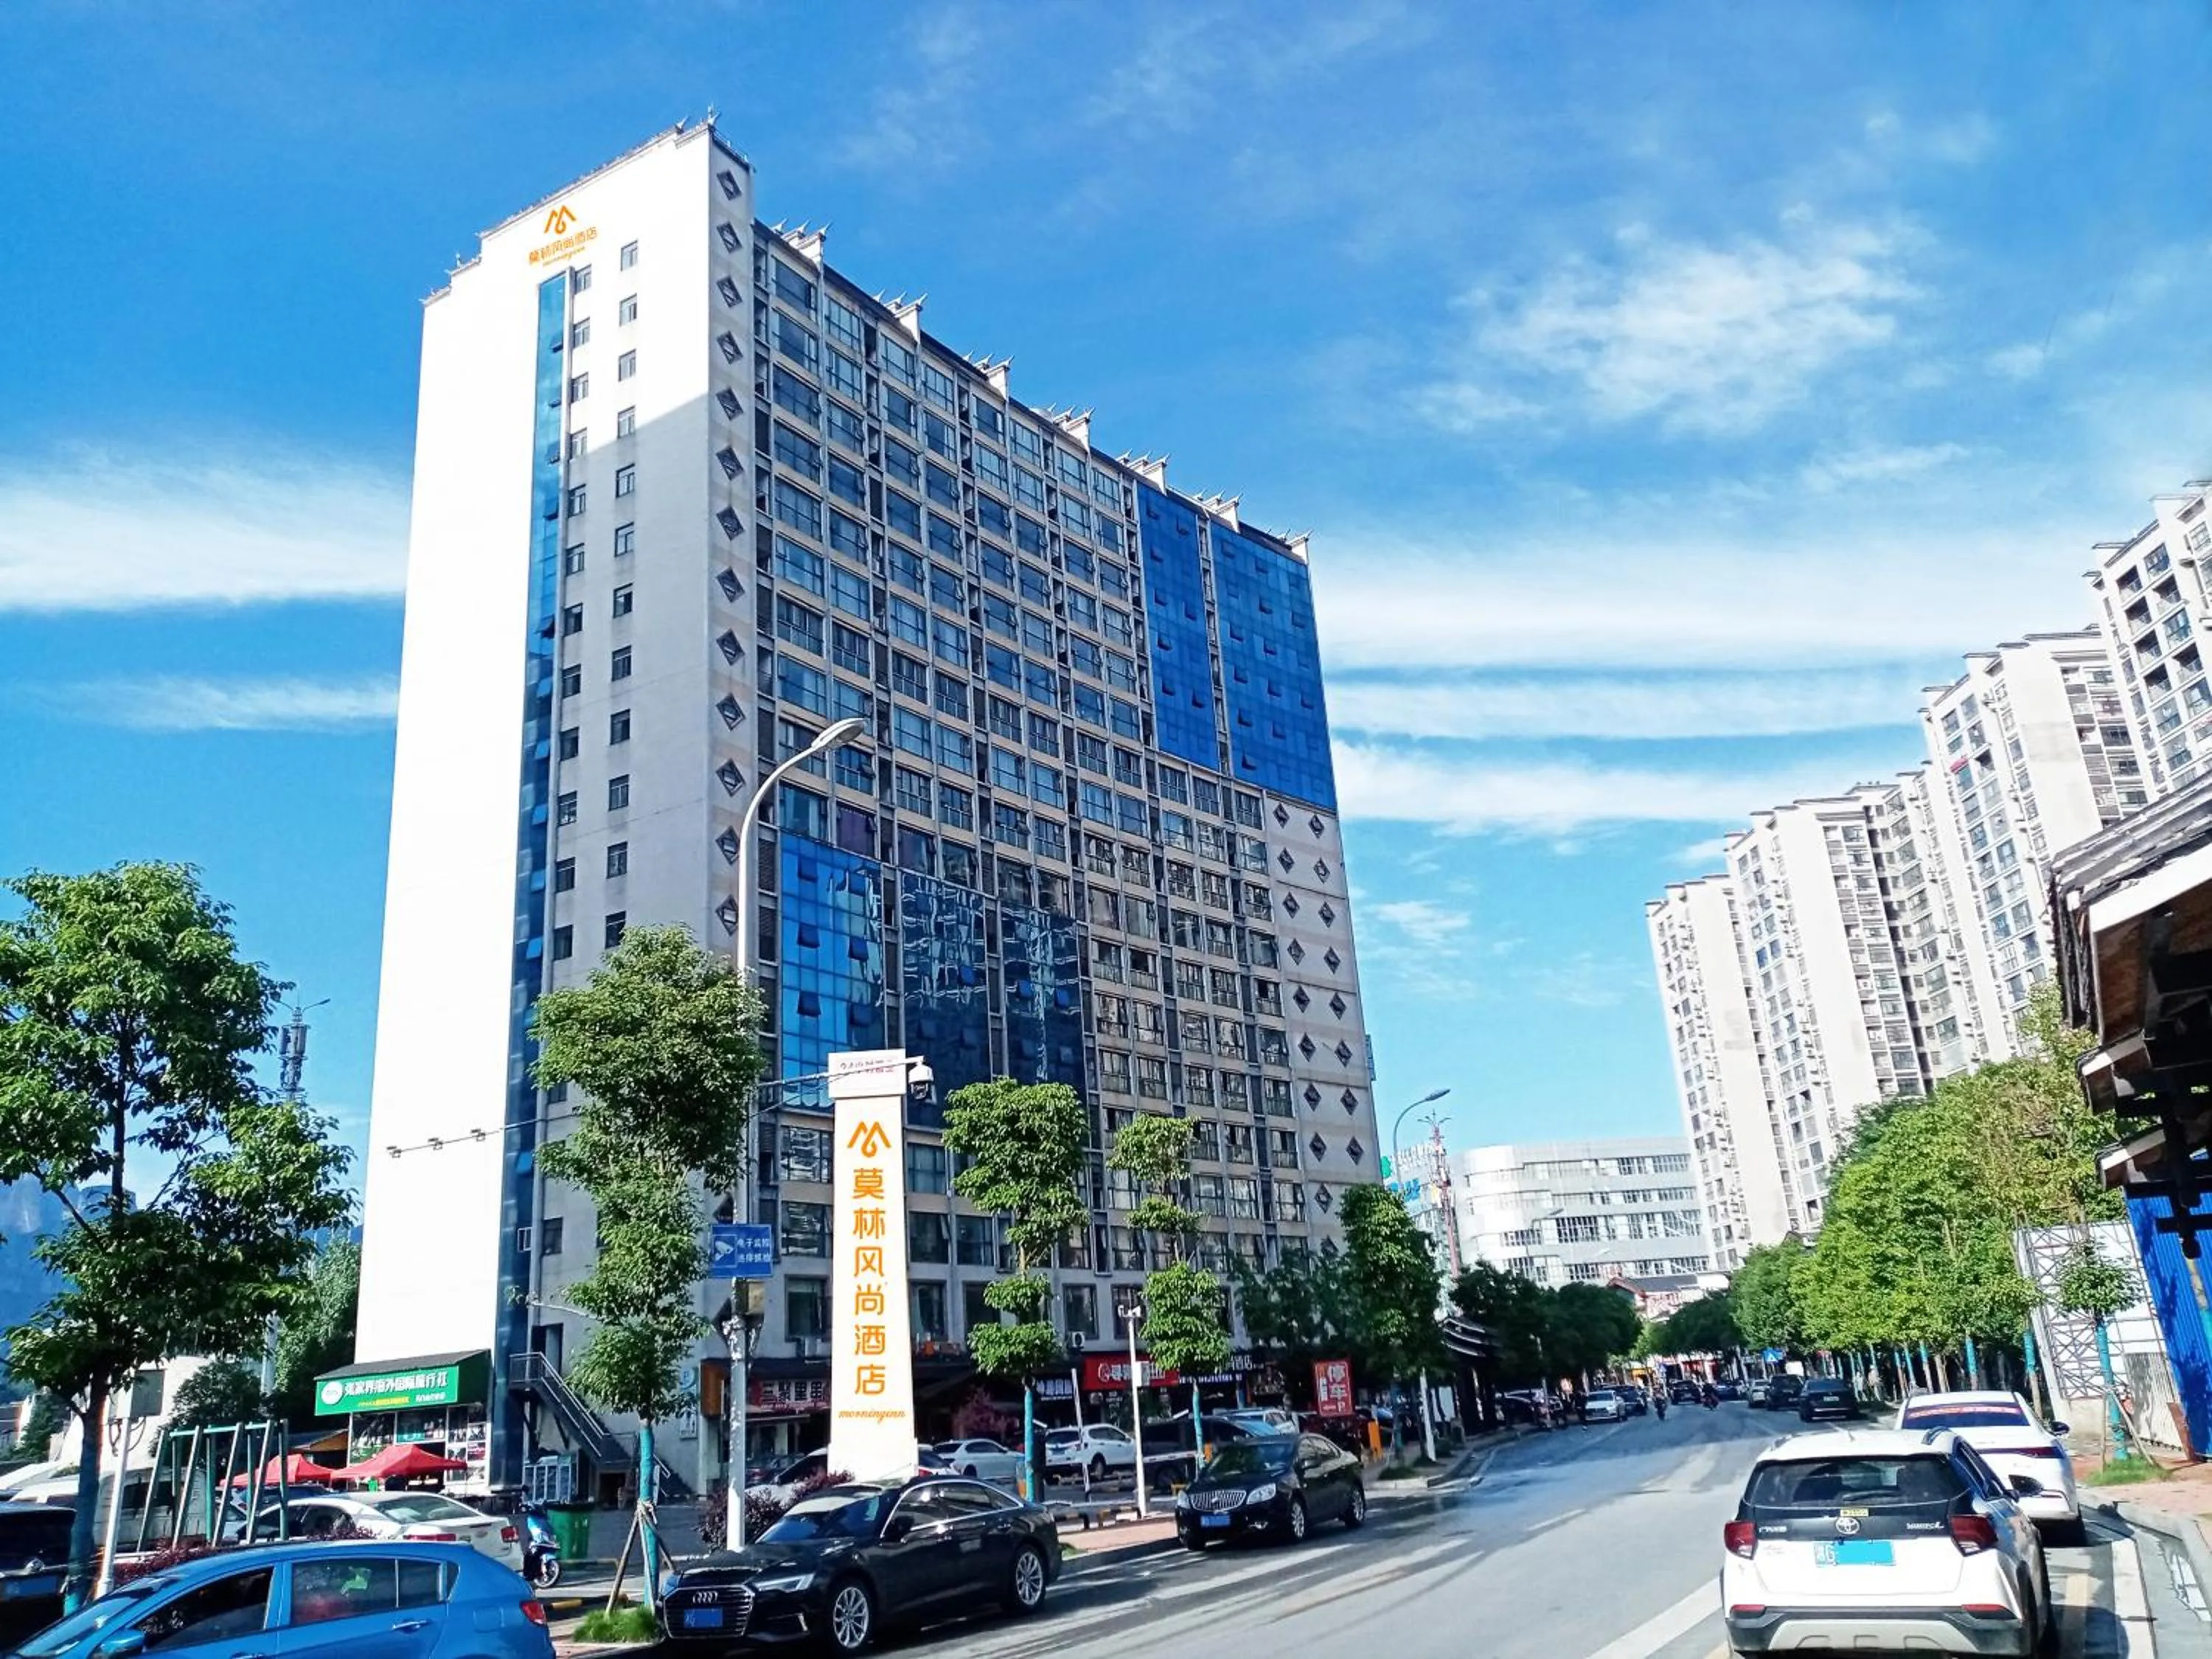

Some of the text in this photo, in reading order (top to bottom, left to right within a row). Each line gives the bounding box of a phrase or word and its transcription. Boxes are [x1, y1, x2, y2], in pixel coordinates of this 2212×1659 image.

[853, 1168, 886, 1395] 莫林风尚酒店
